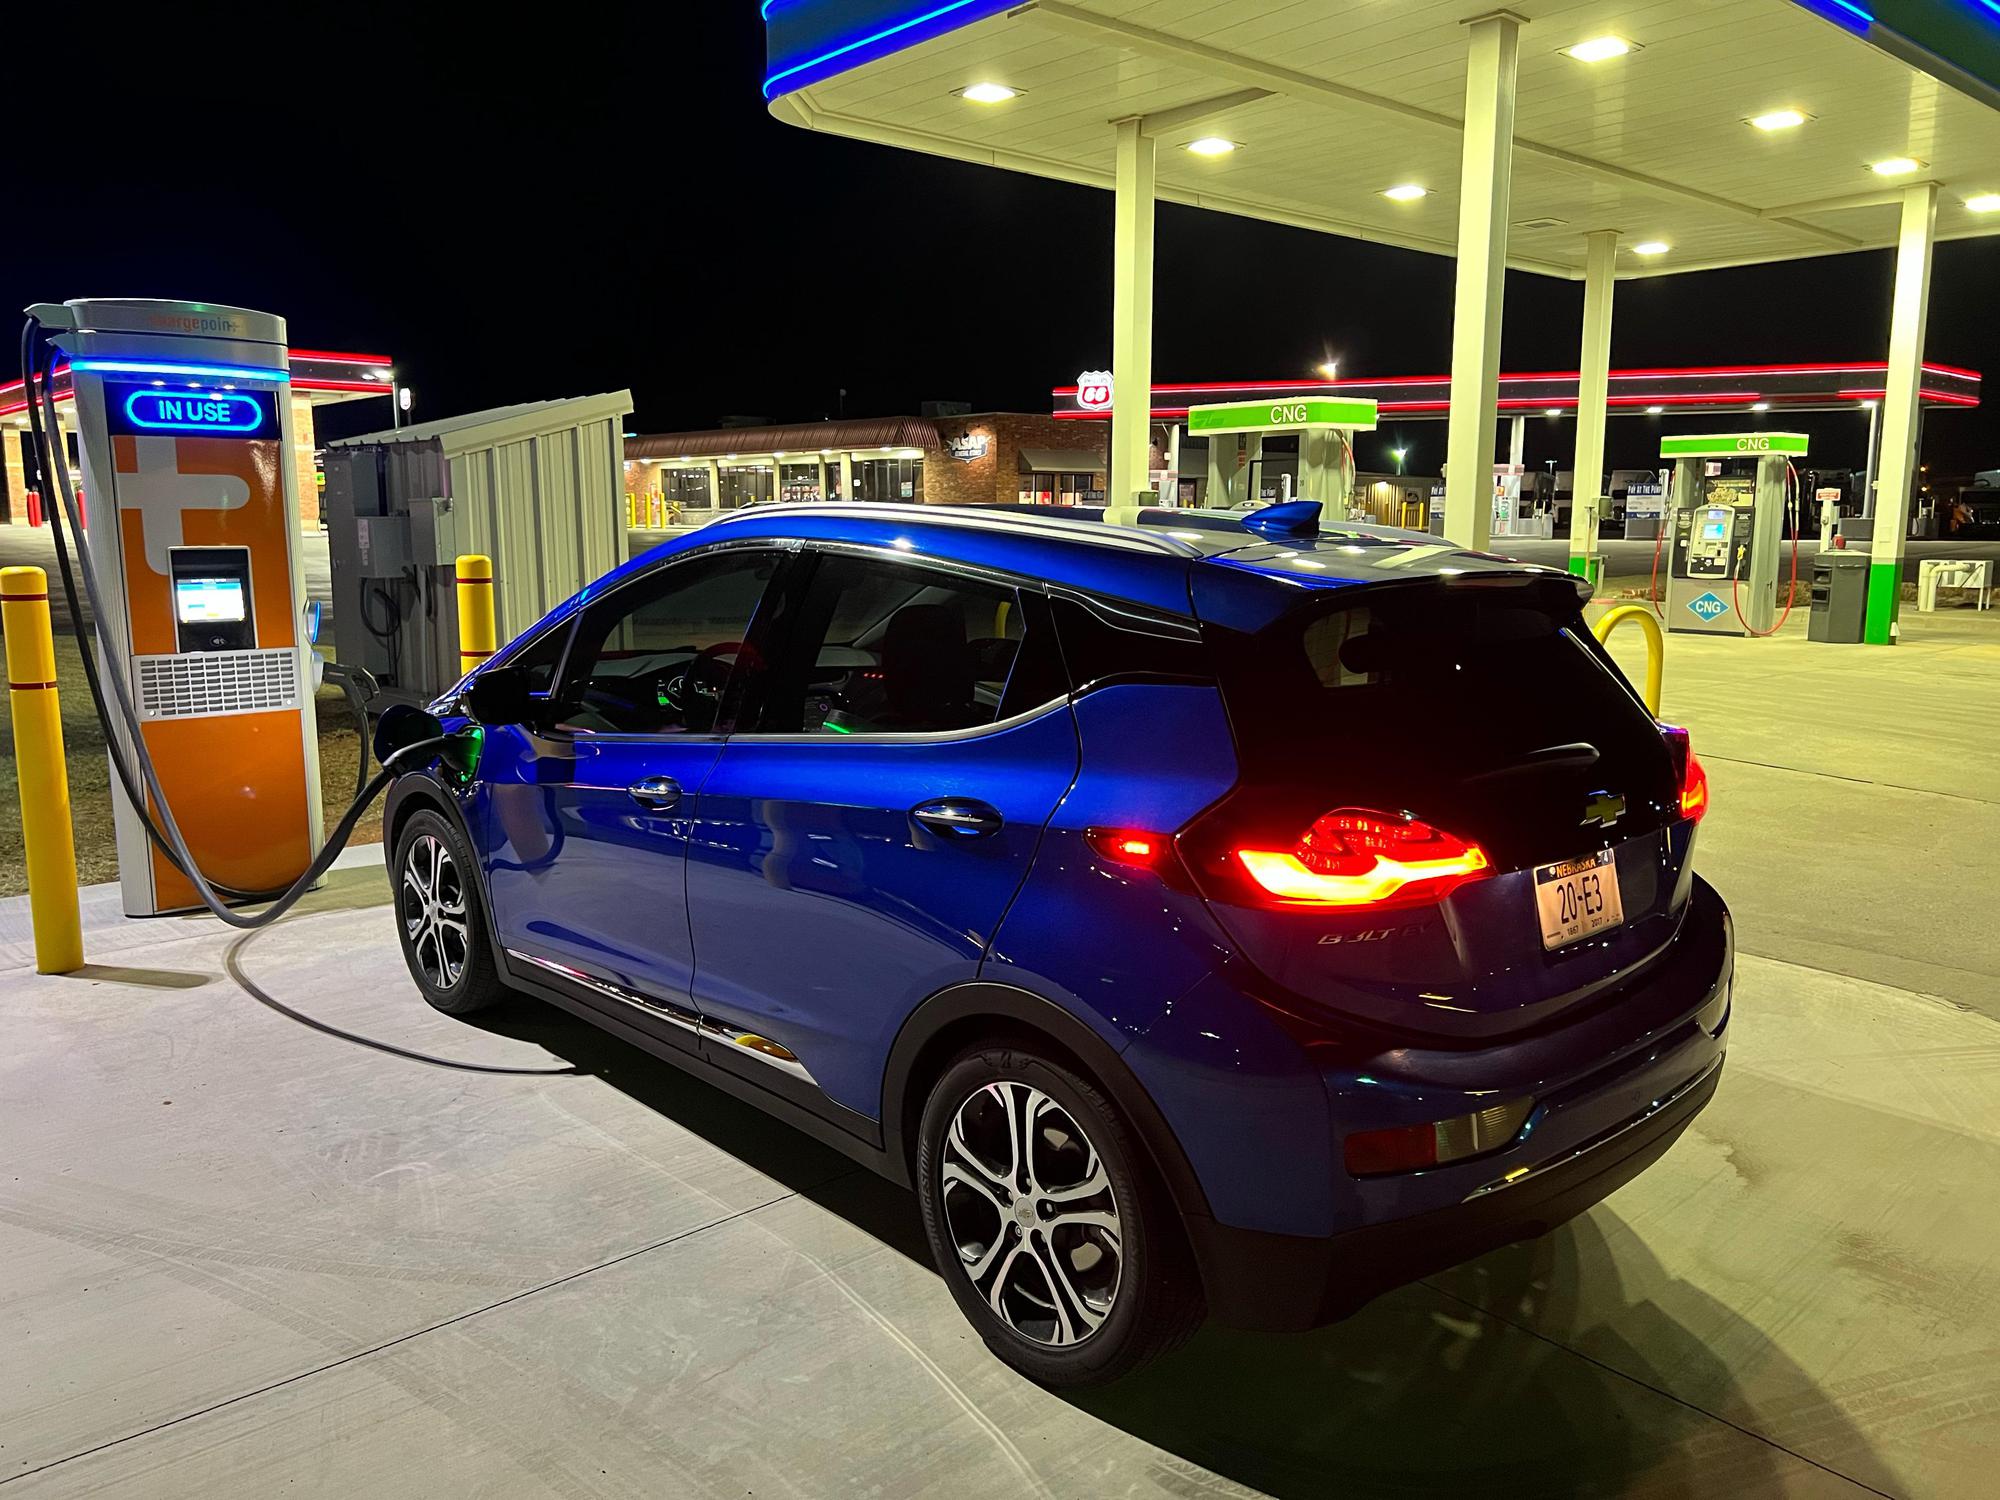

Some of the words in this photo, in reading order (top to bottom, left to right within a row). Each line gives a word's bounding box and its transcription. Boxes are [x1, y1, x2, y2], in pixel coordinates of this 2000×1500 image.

[1084, 387, 1107, 402] 66
[158, 400, 183, 420] IN
[186, 400, 231, 422] USE
[1270, 404, 1307, 424] CNG
[952, 435, 987, 450] ASAP
[1736, 437, 1770, 451] CNG
[1695, 600, 1721, 613] CNG
[1555, 858, 1597, 878] NEBRASKA
[1556, 873, 1603, 925] 20-E3
[919, 1136, 943, 1251] BRIDGESTONE
